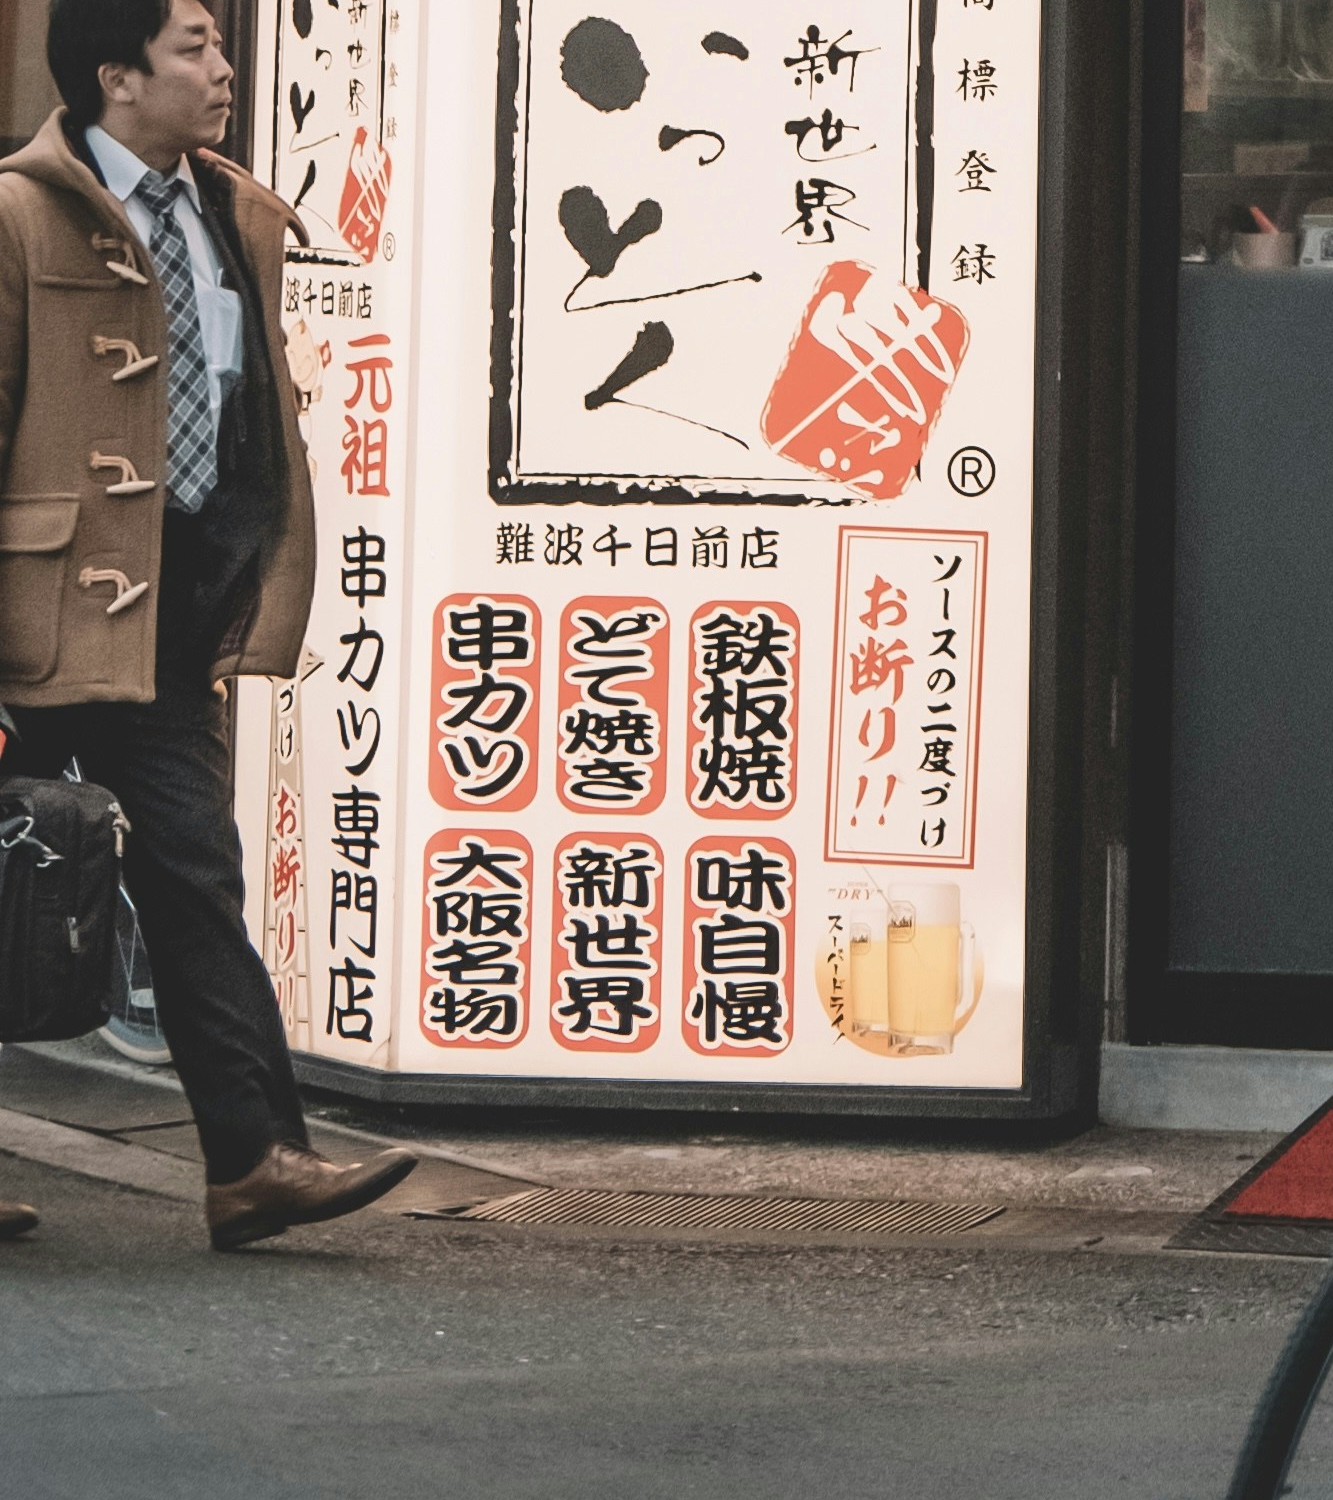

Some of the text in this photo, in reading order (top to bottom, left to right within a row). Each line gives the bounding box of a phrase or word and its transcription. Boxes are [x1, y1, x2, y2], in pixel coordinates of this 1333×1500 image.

[782, 23, 883, 246] 新世界
[495, 522, 781, 571] 難波千日前店
[325, 334, 394, 1045] 元祖串カツ専門店
[445, 603, 528, 799] 串カツ
[563, 613, 658, 802] どて焼き
[698, 613, 790, 805] 鉄板焼
[915, 553, 965, 851] ソースの二度づけ
[430, 842, 523, 1037] 大阪名物
[558, 847, 656, 1037] 新世界
[690, 849, 787, 1045] 味自慢
